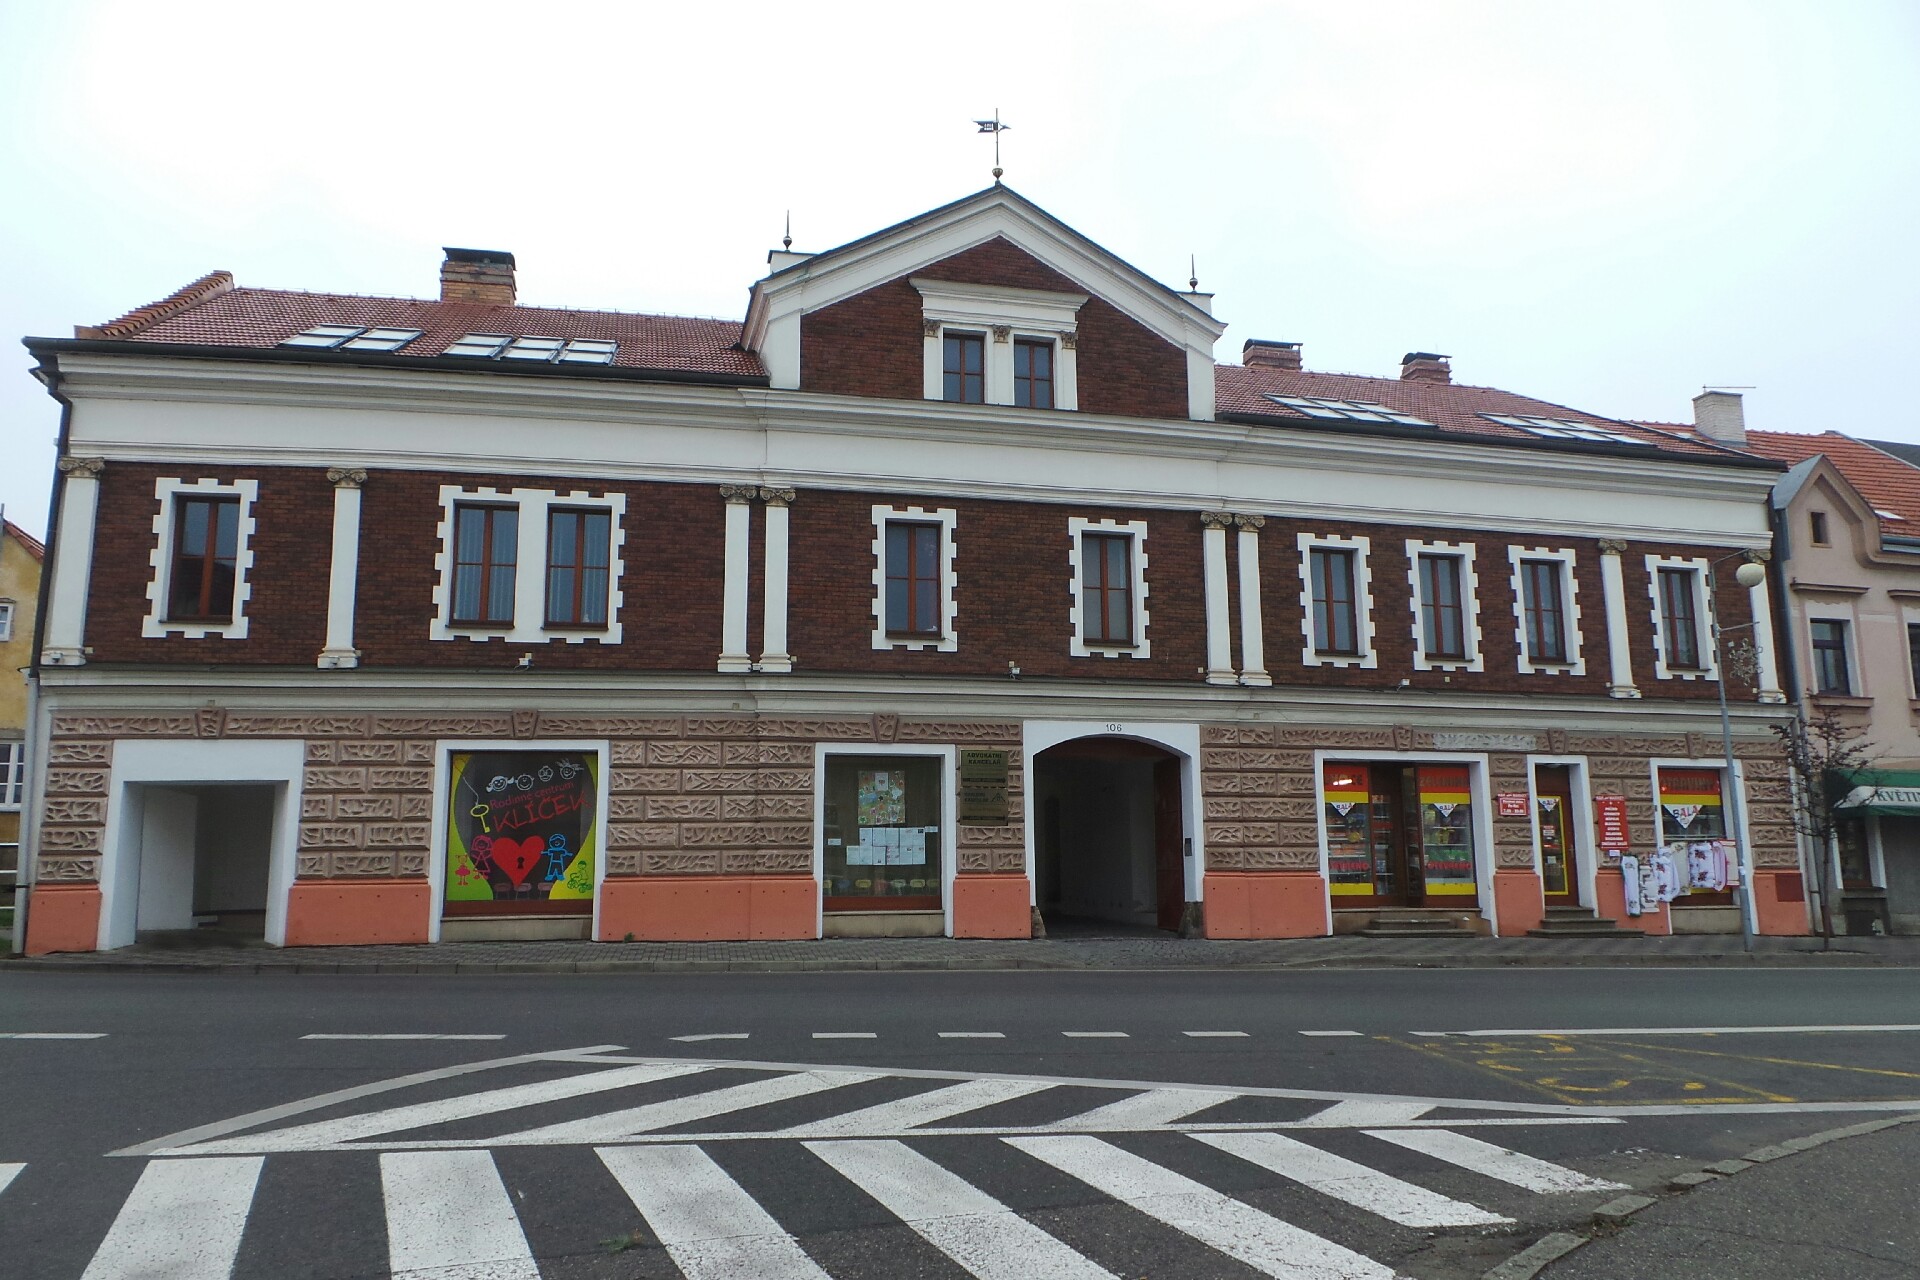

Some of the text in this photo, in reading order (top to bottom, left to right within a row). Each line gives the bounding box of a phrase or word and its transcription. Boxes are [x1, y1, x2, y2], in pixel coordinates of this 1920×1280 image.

[1106, 723, 1122, 732] 106
[535, 782, 574, 797] centrum
[493, 790, 592, 832] KLÍČEK
[1672, 804, 1700, 818] BALA
